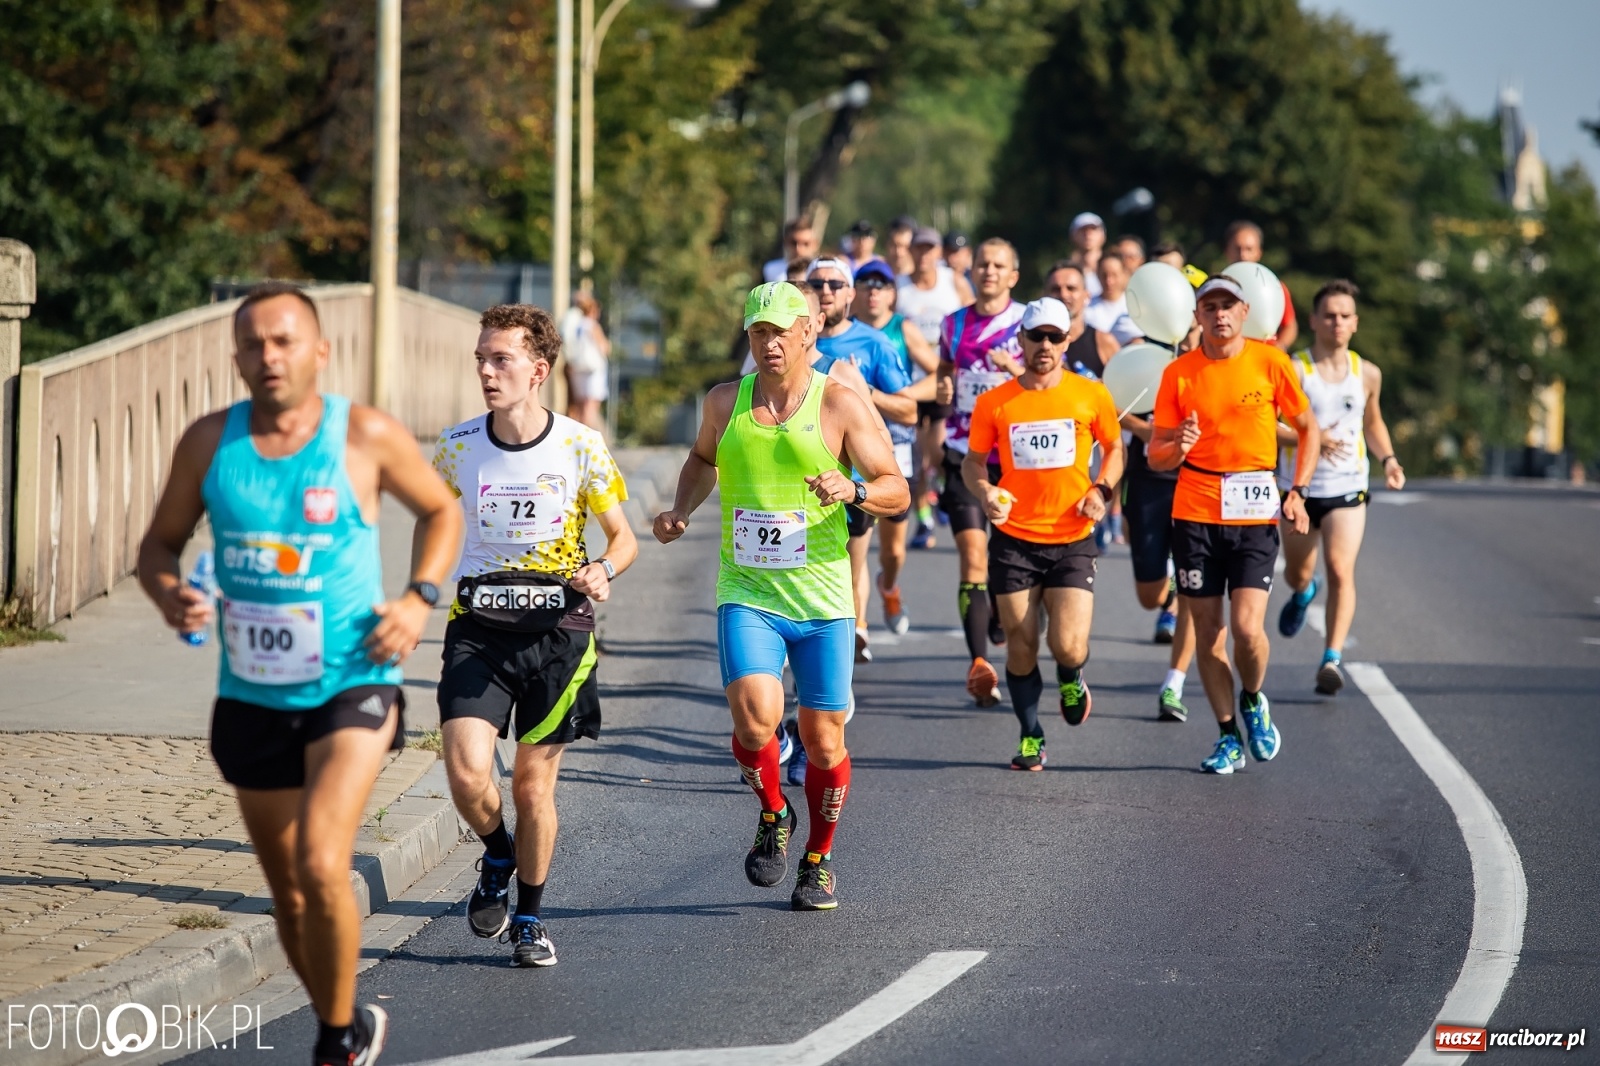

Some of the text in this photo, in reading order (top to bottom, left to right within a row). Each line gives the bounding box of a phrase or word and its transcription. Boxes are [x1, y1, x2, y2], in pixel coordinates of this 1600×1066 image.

[450, 427, 480, 439] COLO
[1030, 434, 1058, 450] 407
[1244, 486, 1270, 500] 194
[510, 500, 536, 520] 72
[758, 526, 782, 546] 92
[1178, 568, 1203, 590] 88
[480, 589, 561, 609] adidas
[248, 626, 293, 652] 100
